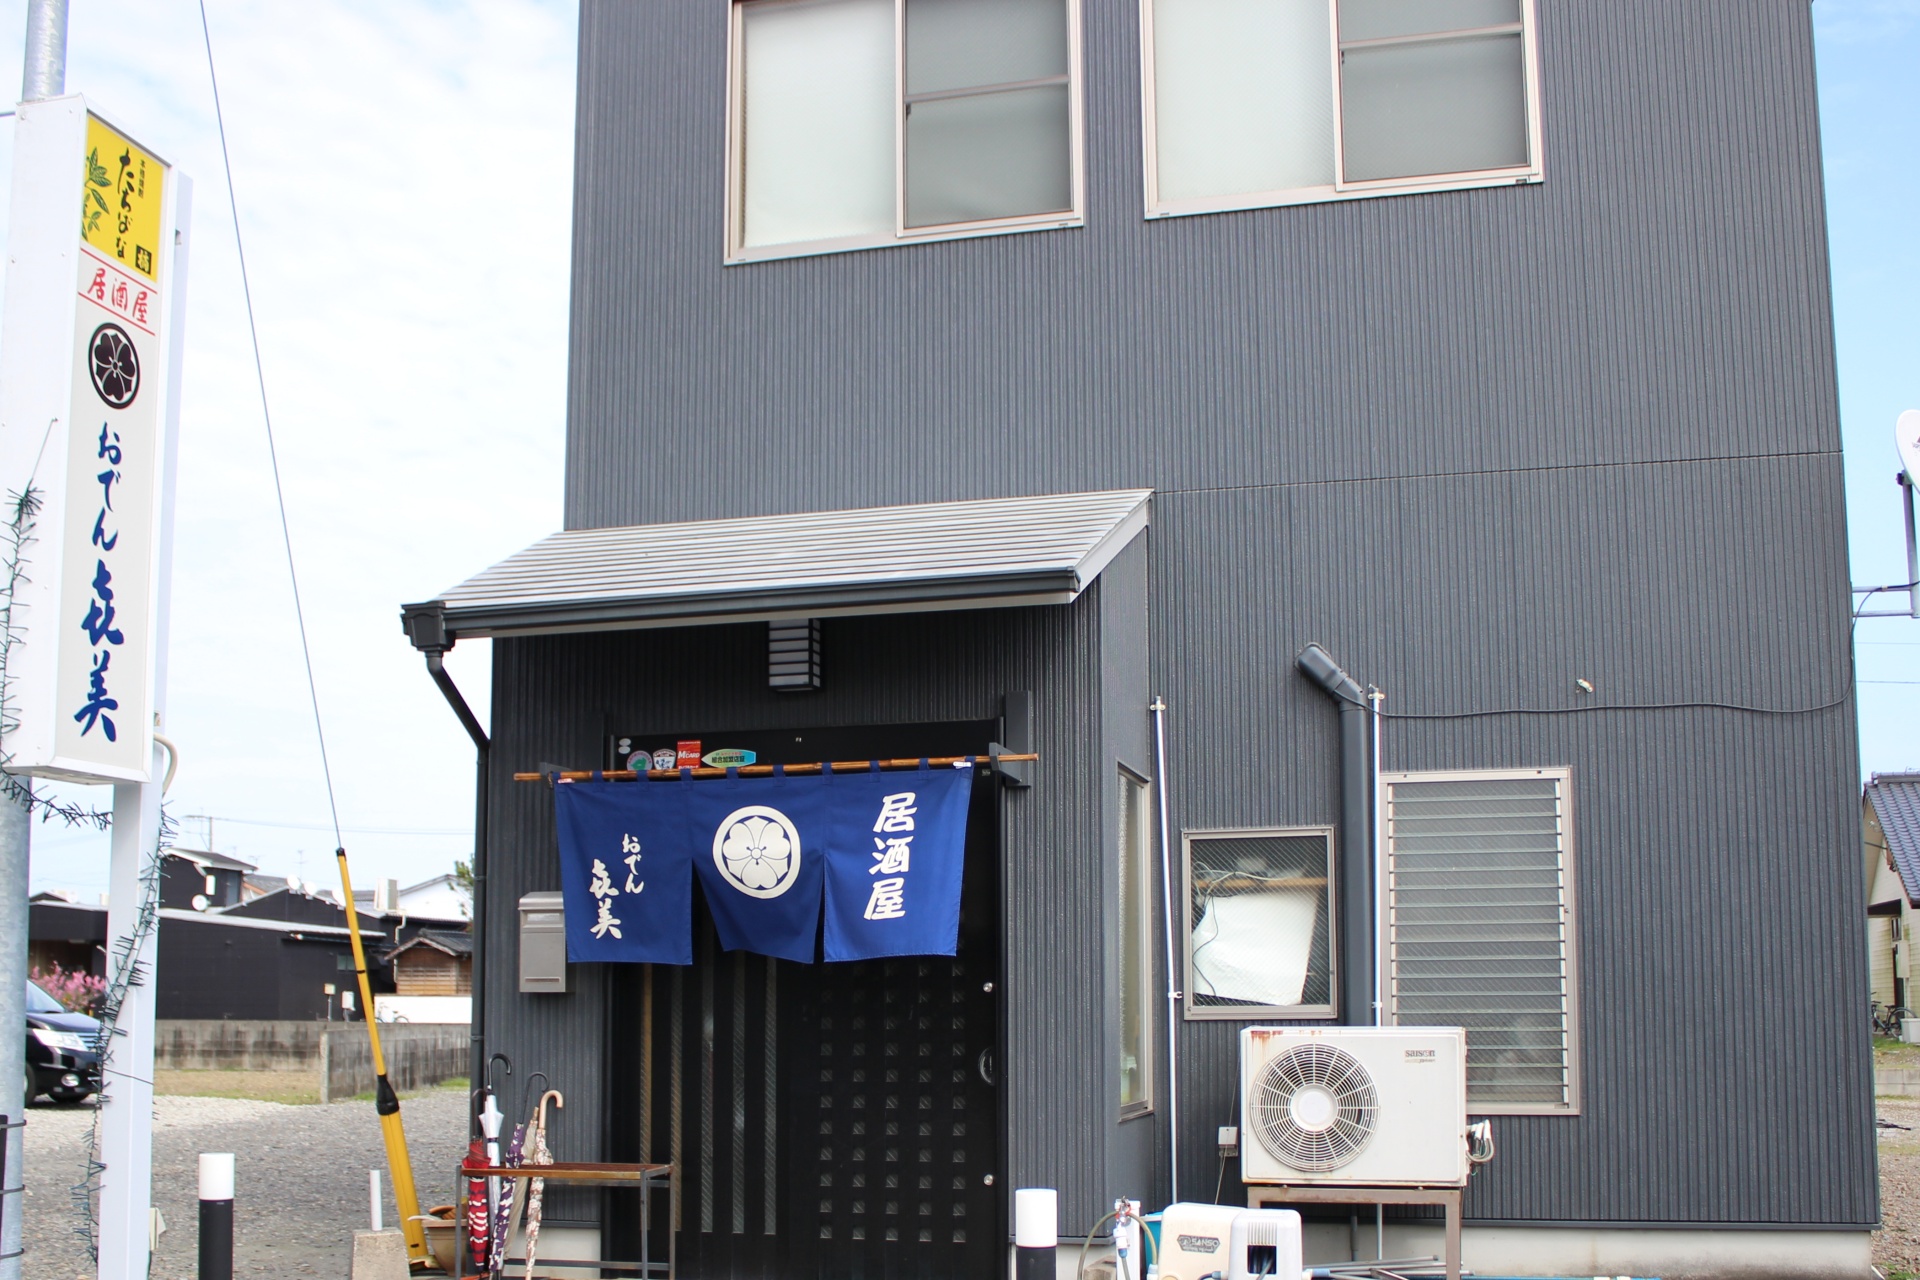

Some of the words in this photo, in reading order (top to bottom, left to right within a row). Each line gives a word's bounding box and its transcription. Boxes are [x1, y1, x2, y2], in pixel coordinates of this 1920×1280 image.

[115, 147, 135, 259] たちばな
[87, 267, 148, 324] 居酒屋
[622, 833, 644, 894] おでん
[864, 792, 917, 920] 居酒屋
[1192, 1237, 1219, 1247] SANSO
